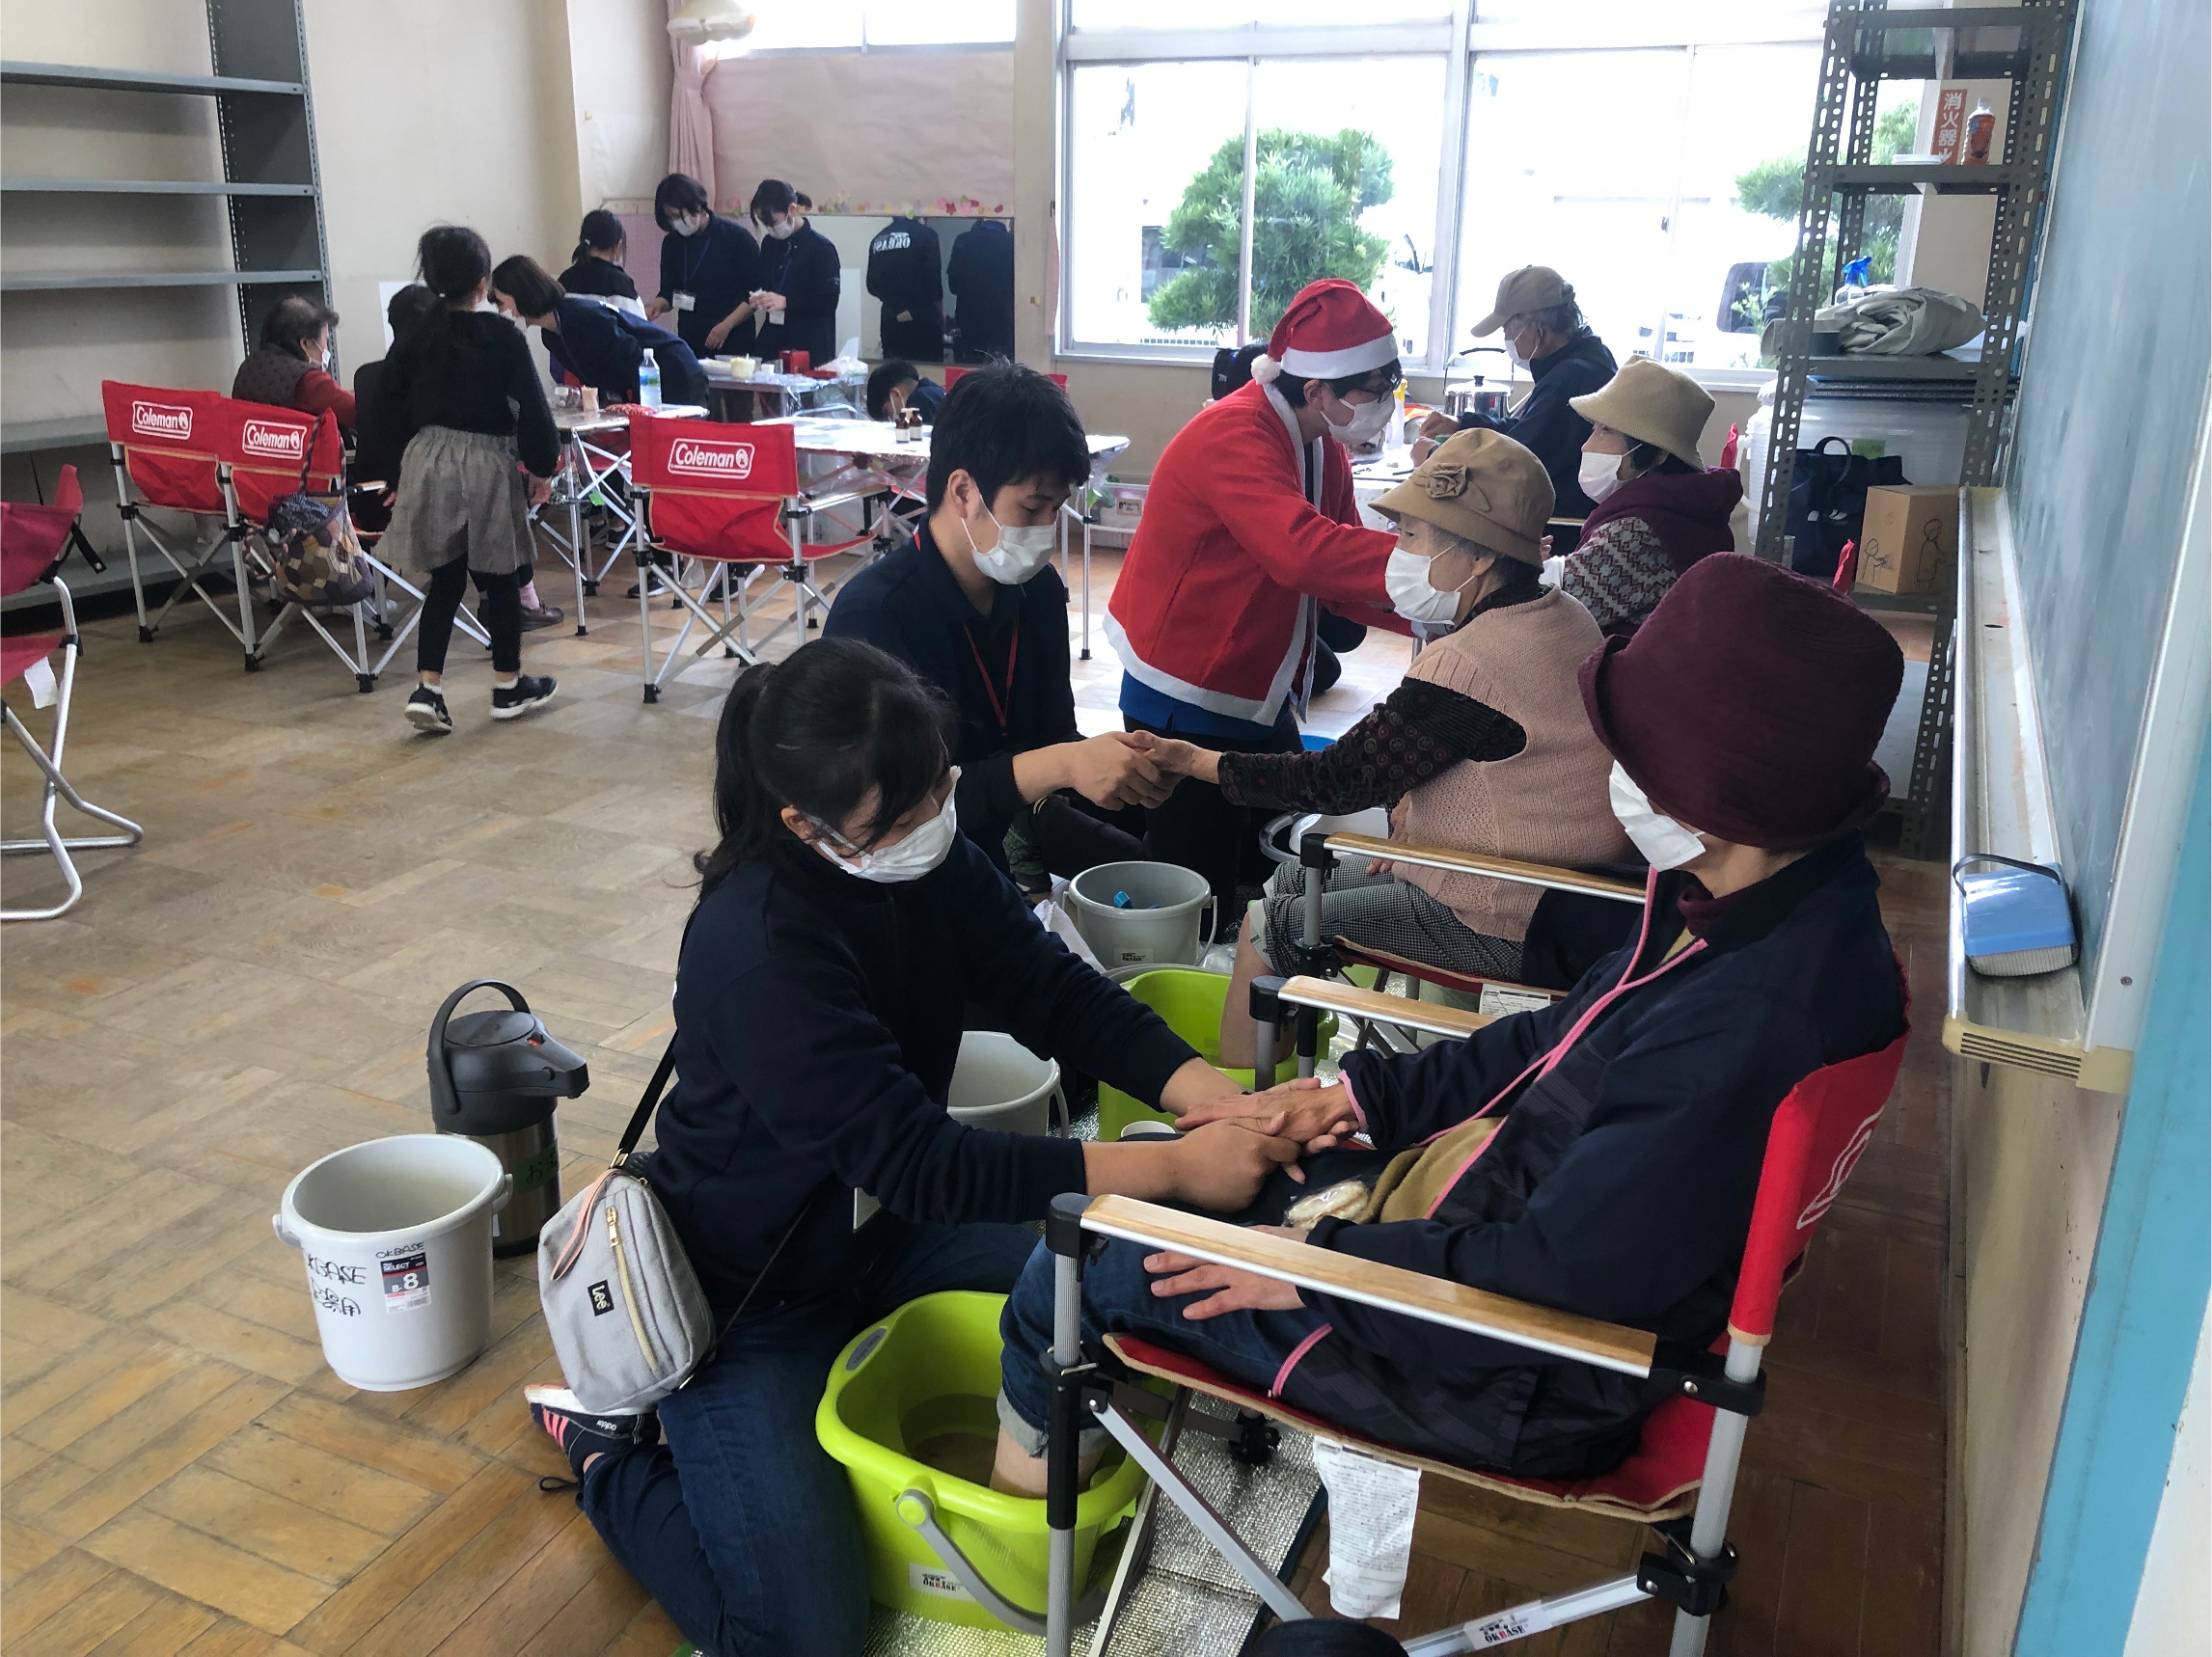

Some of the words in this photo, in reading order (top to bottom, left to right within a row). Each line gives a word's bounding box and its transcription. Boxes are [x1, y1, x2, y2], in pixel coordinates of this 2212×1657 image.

[1937, 92, 1962, 147] 消火器
[136, 405, 178, 429] Coleman
[247, 424, 289, 449] Coleman
[675, 443, 734, 468] Coleman
[375, 1242, 424, 1259] OKBASE
[306, 1253, 367, 1285] KBASE
[383, 1262, 410, 1272] SELECT
[591, 1284, 608, 1311] Lee
[922, 1577, 956, 1591] OKBASE
[1485, 1625, 1525, 1643] OKBASE
